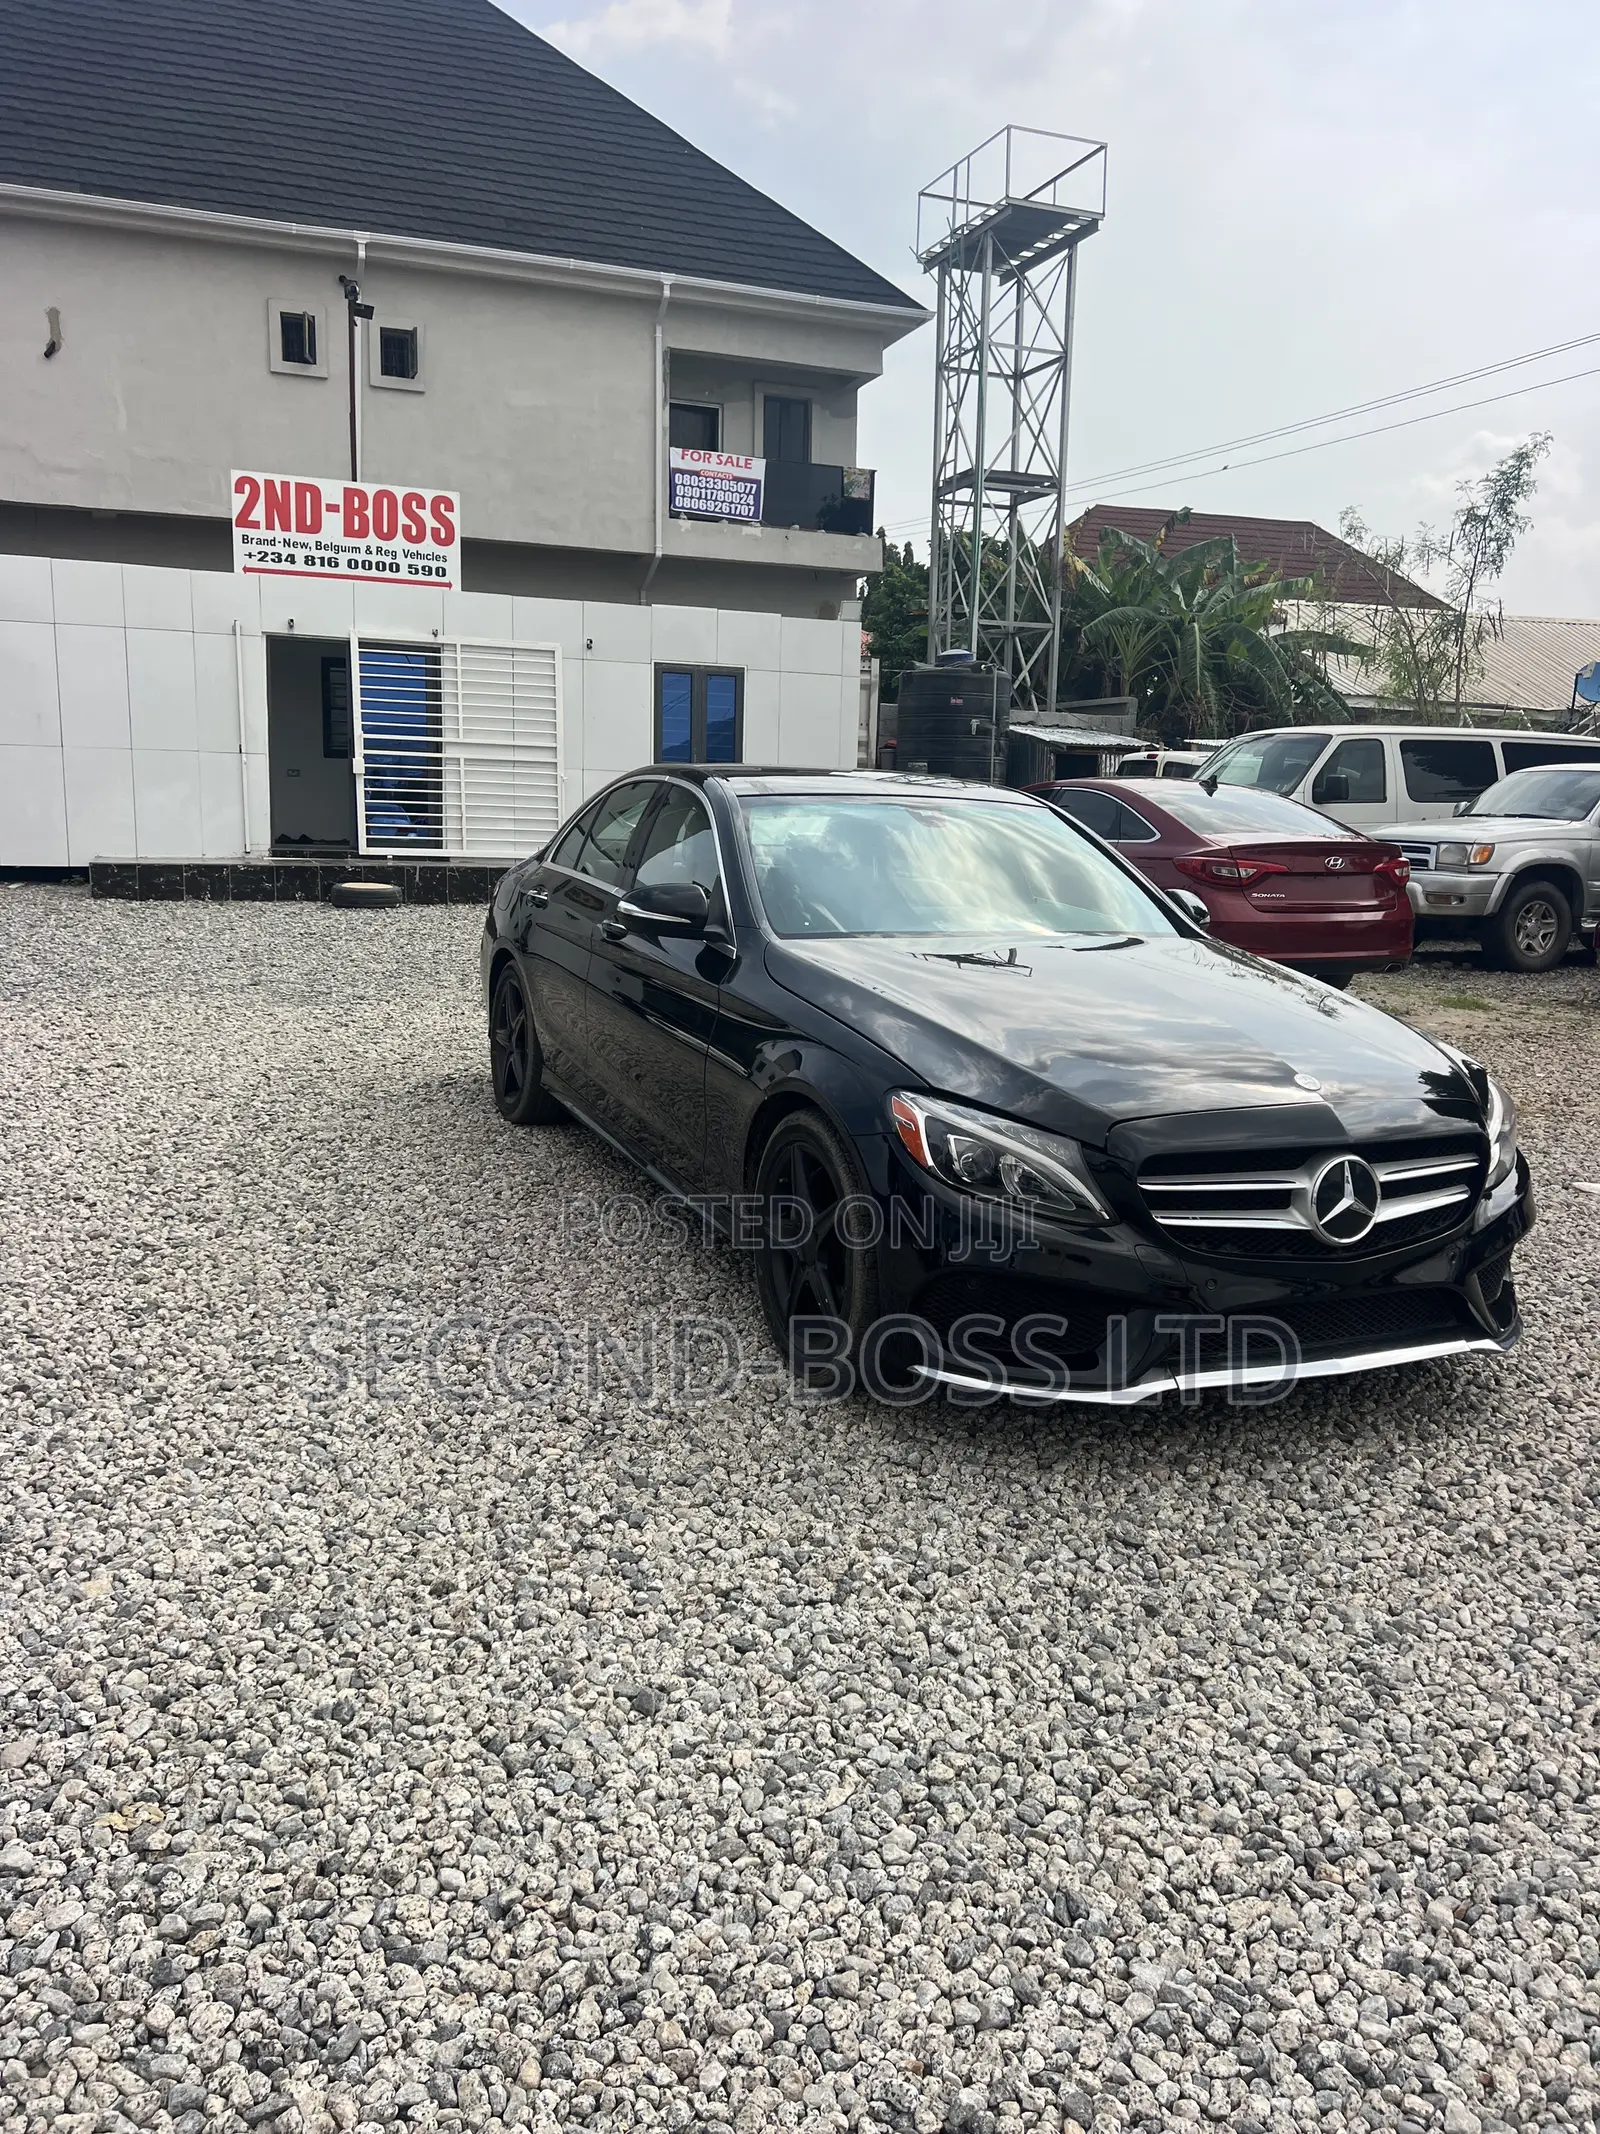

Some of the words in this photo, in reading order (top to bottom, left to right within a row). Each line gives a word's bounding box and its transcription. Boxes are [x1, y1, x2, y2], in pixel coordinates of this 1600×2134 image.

[681, 448, 712, 464] FOR
[716, 453, 753, 470] SALE
[674, 473, 757, 495] 08033305077
[700, 469, 733, 481] CONTACTS
[675, 496, 755, 517] 08069261707
[676, 485, 755, 506] 09011780024
[234, 475, 456, 547] 2ND-BOSS
[241, 534, 312, 552] Brand-New,
[315, 540, 361, 555] Belguim
[365, 544, 373, 555] &
[375, 546, 397, 560] Reg
[402, 549, 448, 563] Vehicles
[243, 550, 297, 565] +234
[304, 555, 340, 569] 816
[346, 558, 401, 574] 0000
[407, 563, 447, 578] 590
